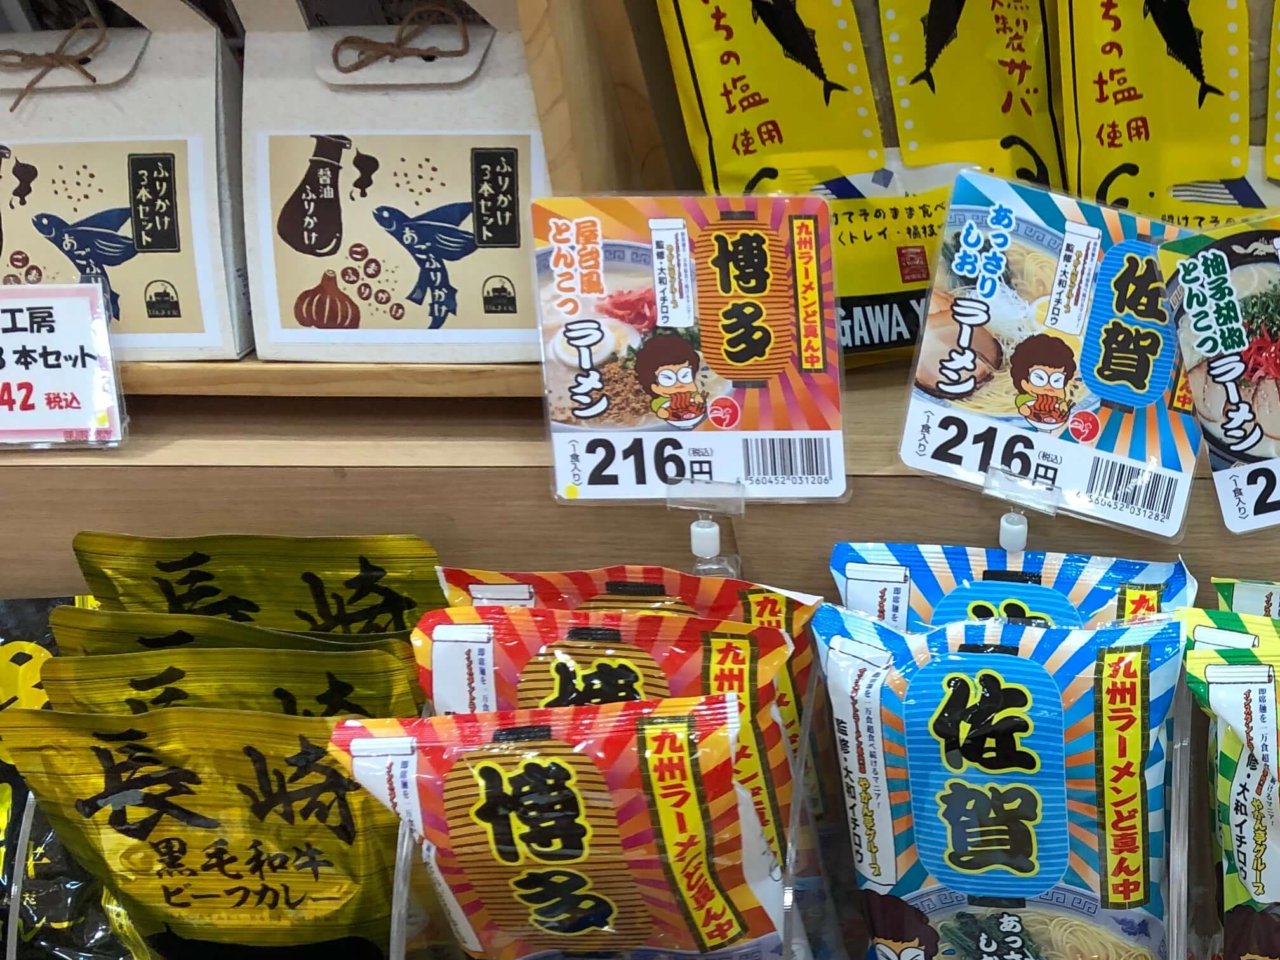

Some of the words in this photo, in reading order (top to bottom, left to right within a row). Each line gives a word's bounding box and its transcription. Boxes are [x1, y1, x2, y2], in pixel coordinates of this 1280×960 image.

[731, 120, 783, 156] 使用
[1096, 116, 1149, 148] 使用
[136, 170, 153, 246] 3本セット
[154, 162, 170, 231] ふりかけ
[301, 185, 318, 246] ふりかけ
[478, 165, 494, 241] 3本セット
[496, 157, 512, 226] ふりかけ
[551, 219, 578, 315] とんこつ
[575, 220, 604, 295] 屋台風
[952, 222, 983, 276] しお
[979, 204, 1015, 299] あっさり
[0, 306, 56, 333] 工房
[711, 233, 771, 364] 博多
[796, 222, 821, 368] 九州ラーメンど真ん中
[1098, 256, 1168, 391] 佐賀
[1180, 261, 1219, 354] とんこつ
[563, 320, 608, 419] ラーメン
[938, 298, 991, 395] ラーメン
[44, 392, 82, 409] 税込
[1208, 354, 1263, 452] ラーメン
[74, 728, 362, 845] 長崎
[930, 669, 1041, 874] 佐賀
[1106, 656, 1142, 899] 九州ラーメンど真ん中
[149, 839, 335, 881] 黒毛和牛
[470, 758, 618, 935] 博多
[161, 884, 345, 910] ビーフカレー
